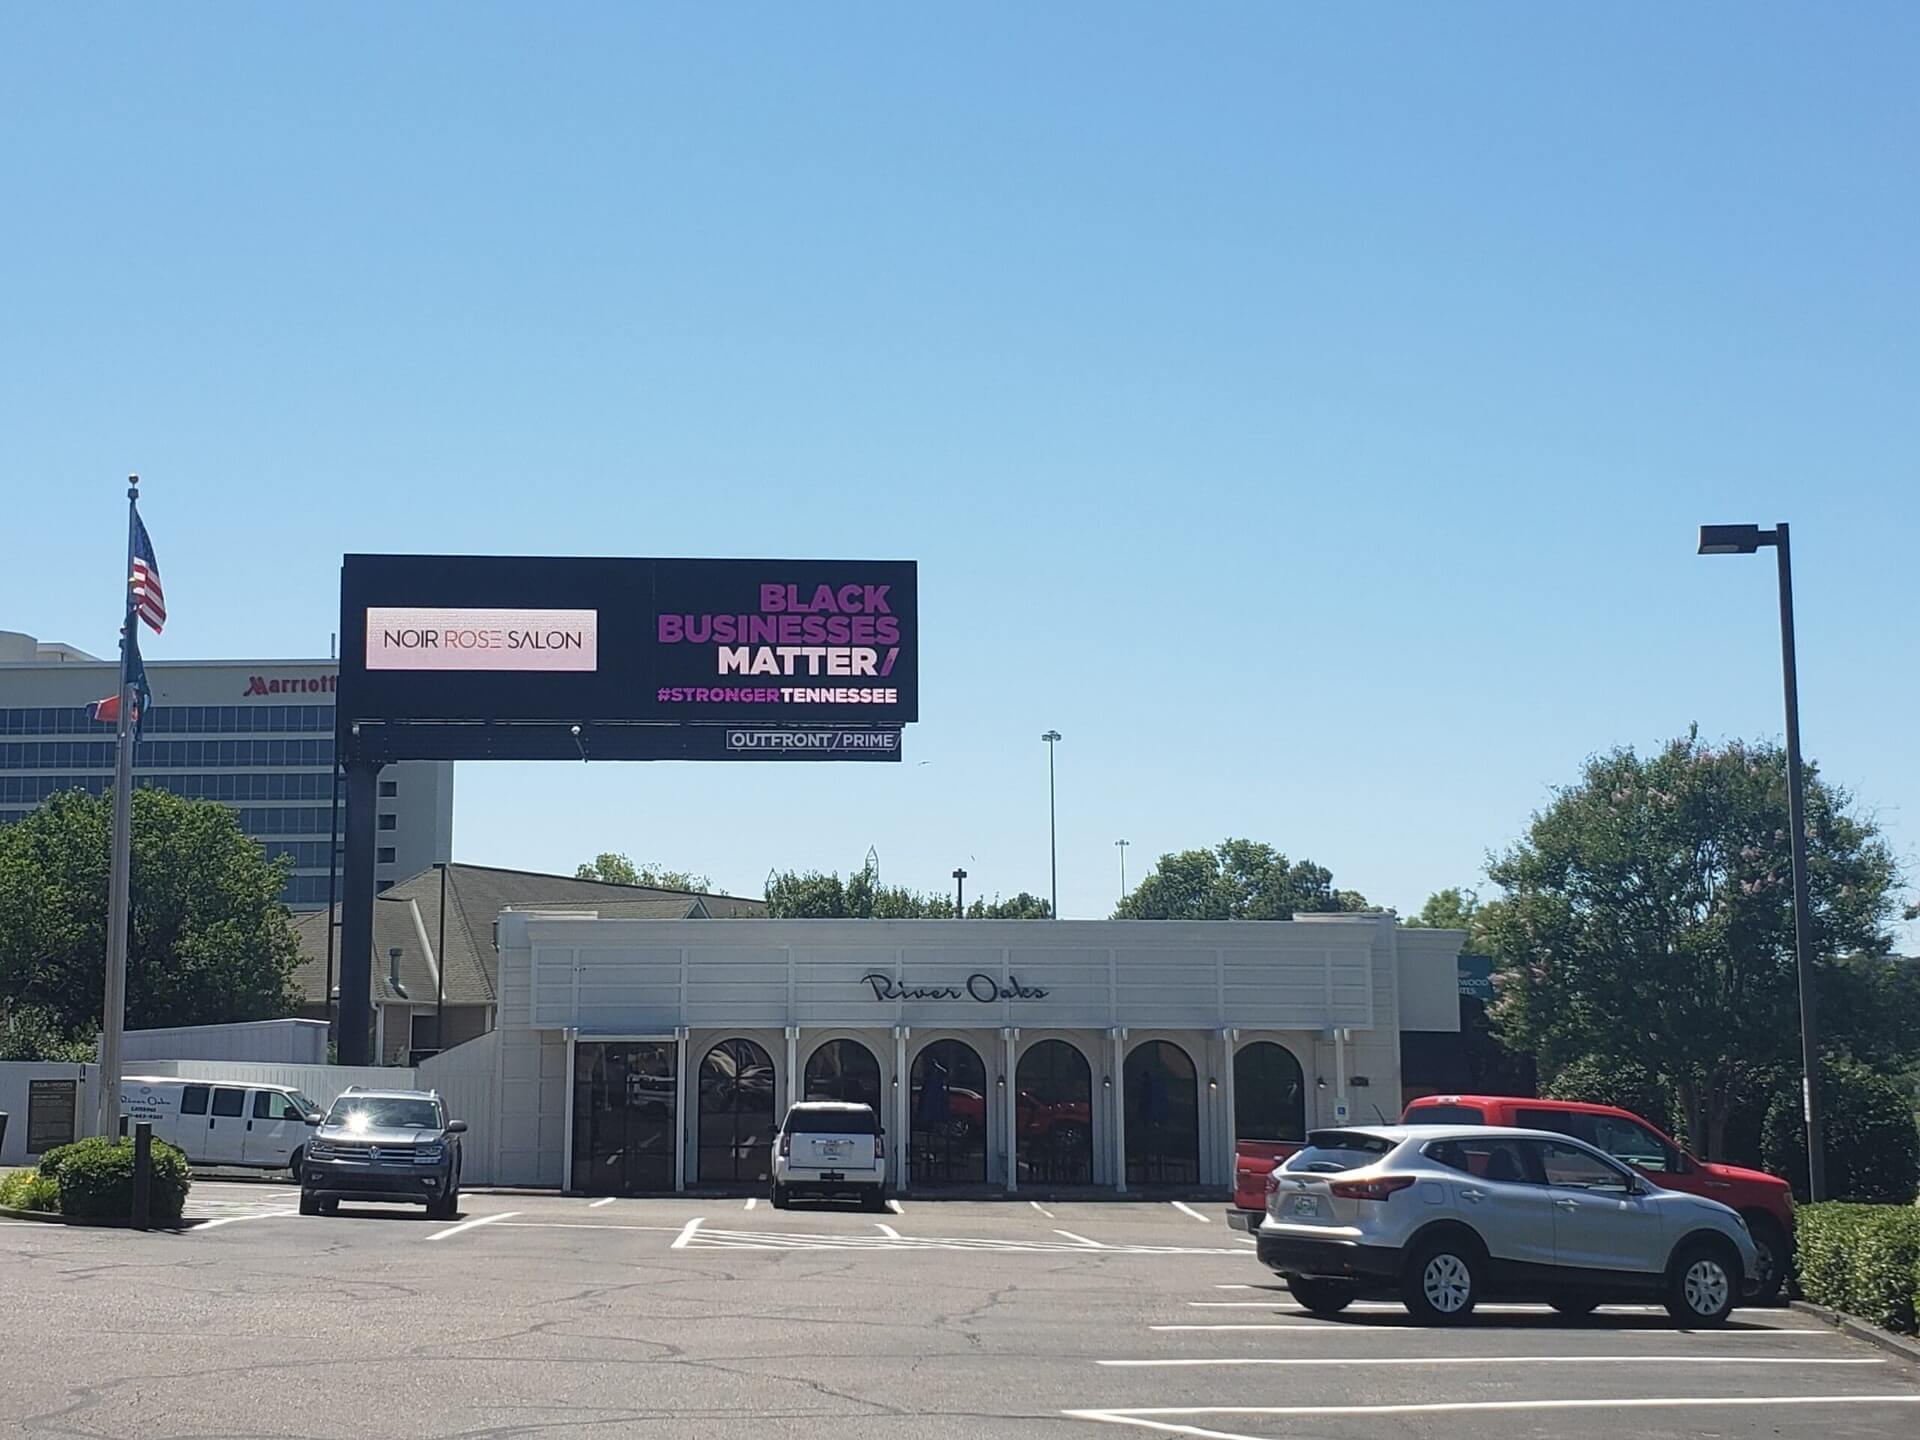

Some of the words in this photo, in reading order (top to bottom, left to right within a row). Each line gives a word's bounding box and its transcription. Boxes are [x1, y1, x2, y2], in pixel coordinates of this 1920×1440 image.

[760, 584, 890, 613] BLACK
[384, 630, 438, 648] NOIR
[445, 630, 502, 648] ROSE
[508, 631, 581, 649] SALON
[658, 614, 900, 644] BUSINESSES
[860, 973, 962, 1002] River
[966, 974, 1049, 1003] Oaks
